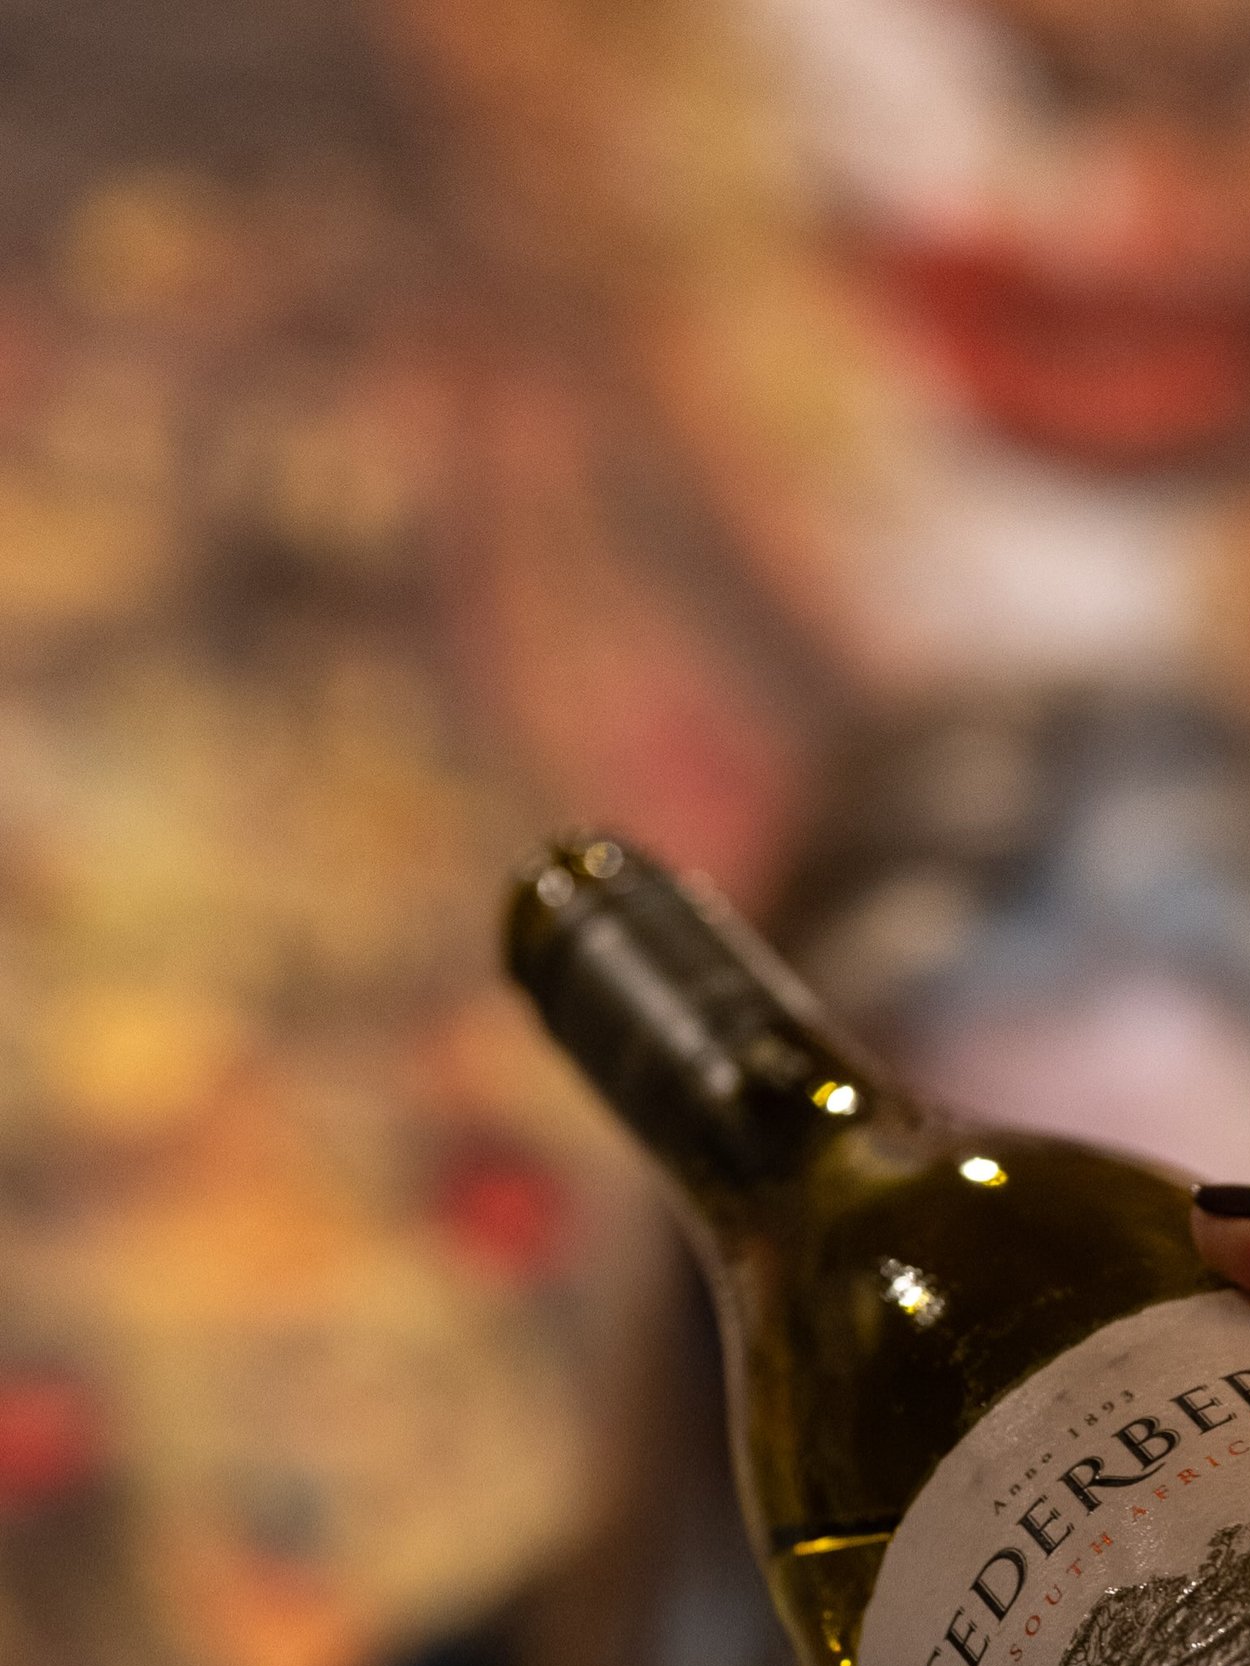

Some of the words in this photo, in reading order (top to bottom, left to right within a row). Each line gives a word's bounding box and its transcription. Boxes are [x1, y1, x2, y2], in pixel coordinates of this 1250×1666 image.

[992, 1451, 1053, 1516] Anno
[1068, 1389, 1136, 1439] 1893
[1009, 1532, 1114, 1662] SOUTH
